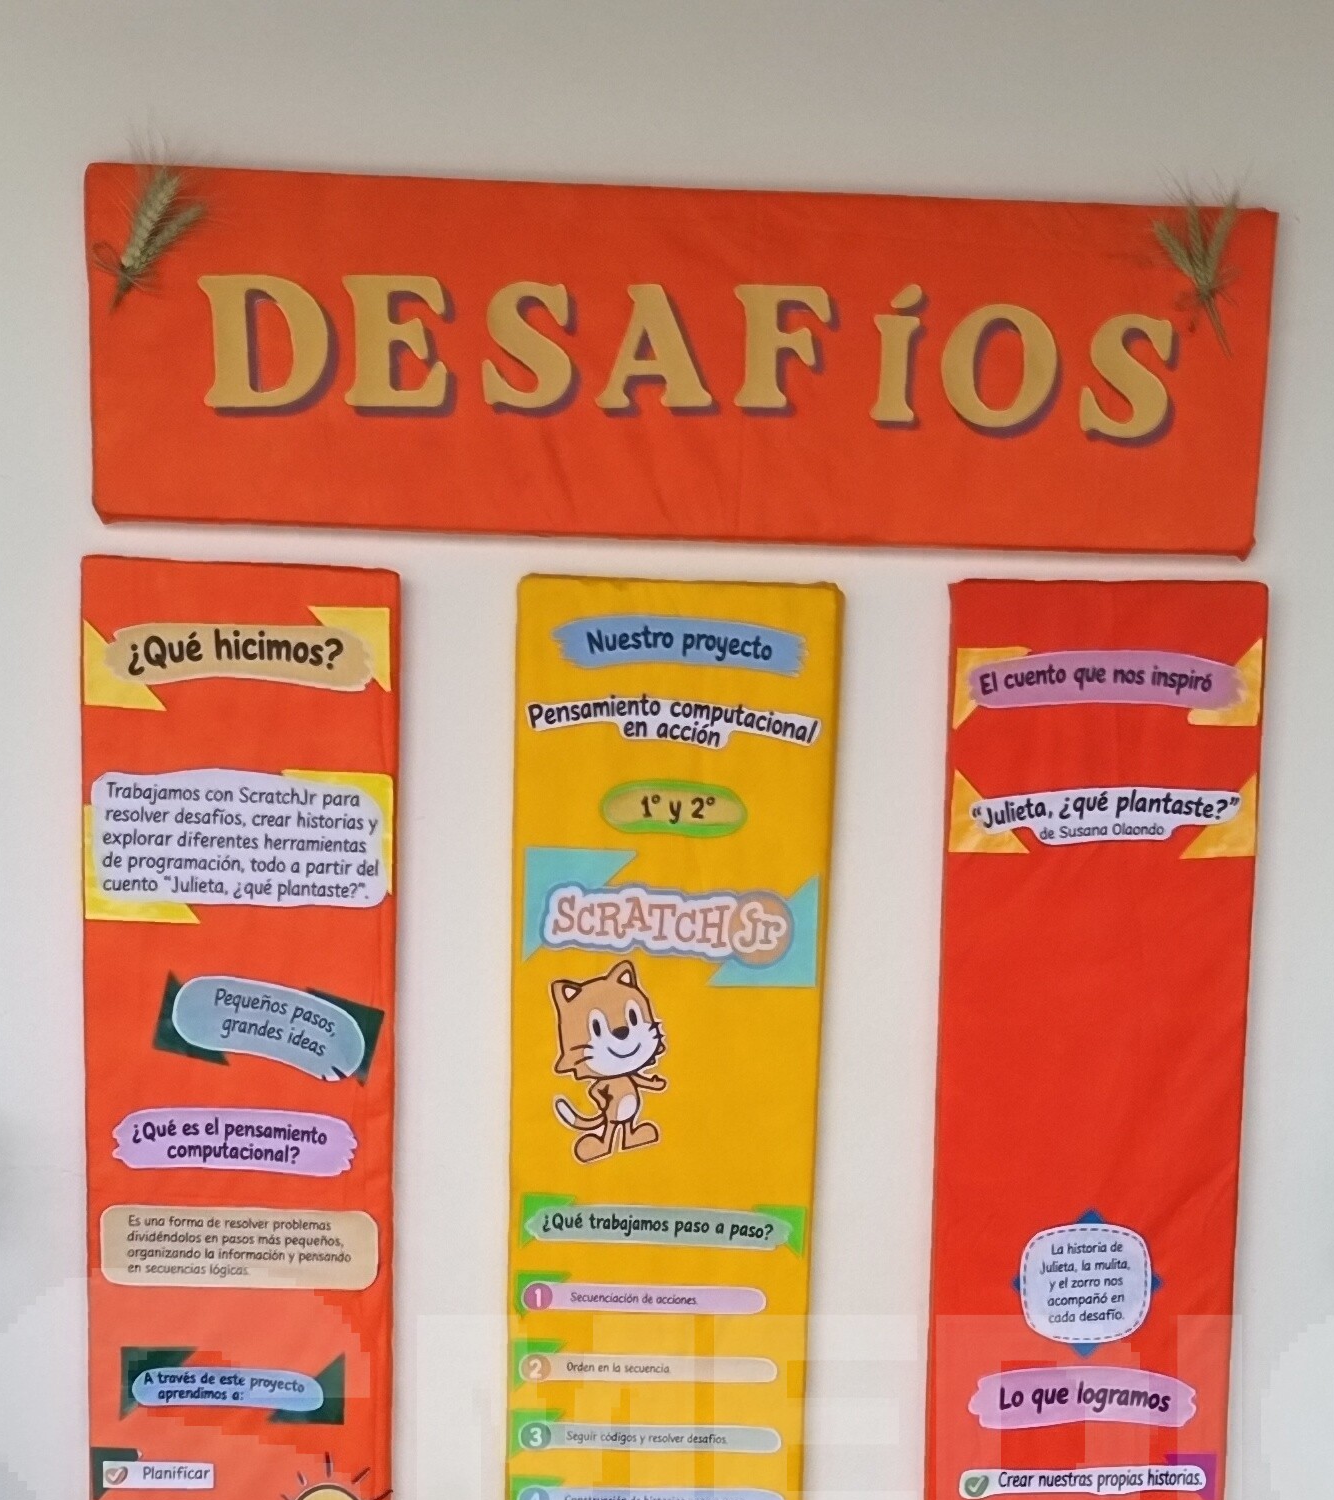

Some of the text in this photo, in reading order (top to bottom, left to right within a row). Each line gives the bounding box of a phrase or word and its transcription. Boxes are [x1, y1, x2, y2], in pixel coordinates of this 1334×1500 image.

[128, 629, 343, 676] ¿Qué hicimos?
[586, 625, 773, 662] Nuestro proyecto
[979, 664, 1212, 696] El cuento que nos inspiró
[528, 693, 818, 744] Pensamiento computacional
[623, 719, 721, 748] en acción
[106, 781, 360, 809] Trabajamos con ScratchJr para
[1059, 791, 1109, 820] ¿qué
[105, 806, 378, 834] resolver desafíos, crear historias y
[668, 799, 682, 825] y
[103, 830, 367, 854] explorar diferentes herramientas
[1039, 823, 1165, 840] de Susana Olaondo
[102, 853, 378, 878] de programación, todo a partir del
[103, 878, 159, 892] cuento
[233, 880, 273, 899] ¿qué
[215, 988, 336, 1036] Pequeños pasos,
[221, 1015, 326, 1057] grandes ideas
[132, 1117, 327, 1146] ¿Qué es el pensamiento
[167, 1144, 300, 1165] computacional?
[128, 1215, 331, 1233] Es una forma de resolver problemas
[543, 1212, 774, 1240] ¿Qué trabajamos paso a paso?
[127, 1232, 344, 1249] dividéndolos en pasos más pequeños,
[1051, 1241, 1123, 1255] La historia de
[127, 1247, 351, 1265] organizando la información y pensando
[1039, 1258, 1130, 1275] Julieta, la mulita,
[1049, 1277, 1123, 1292] y el zorro nos
[1047, 1292, 1124, 1307] acompañó en
[1049, 1311, 1076, 1323] cada
[144, 1372, 305, 1396] A través de este proyecto
[158, 1388, 228, 1402] aprendimos
[1000, 1382, 1171, 1415] Lo que logramos
[143, 1466, 211, 1481] Planificar
[998, 1469, 1202, 1492] Crear nuestras propias historias.
